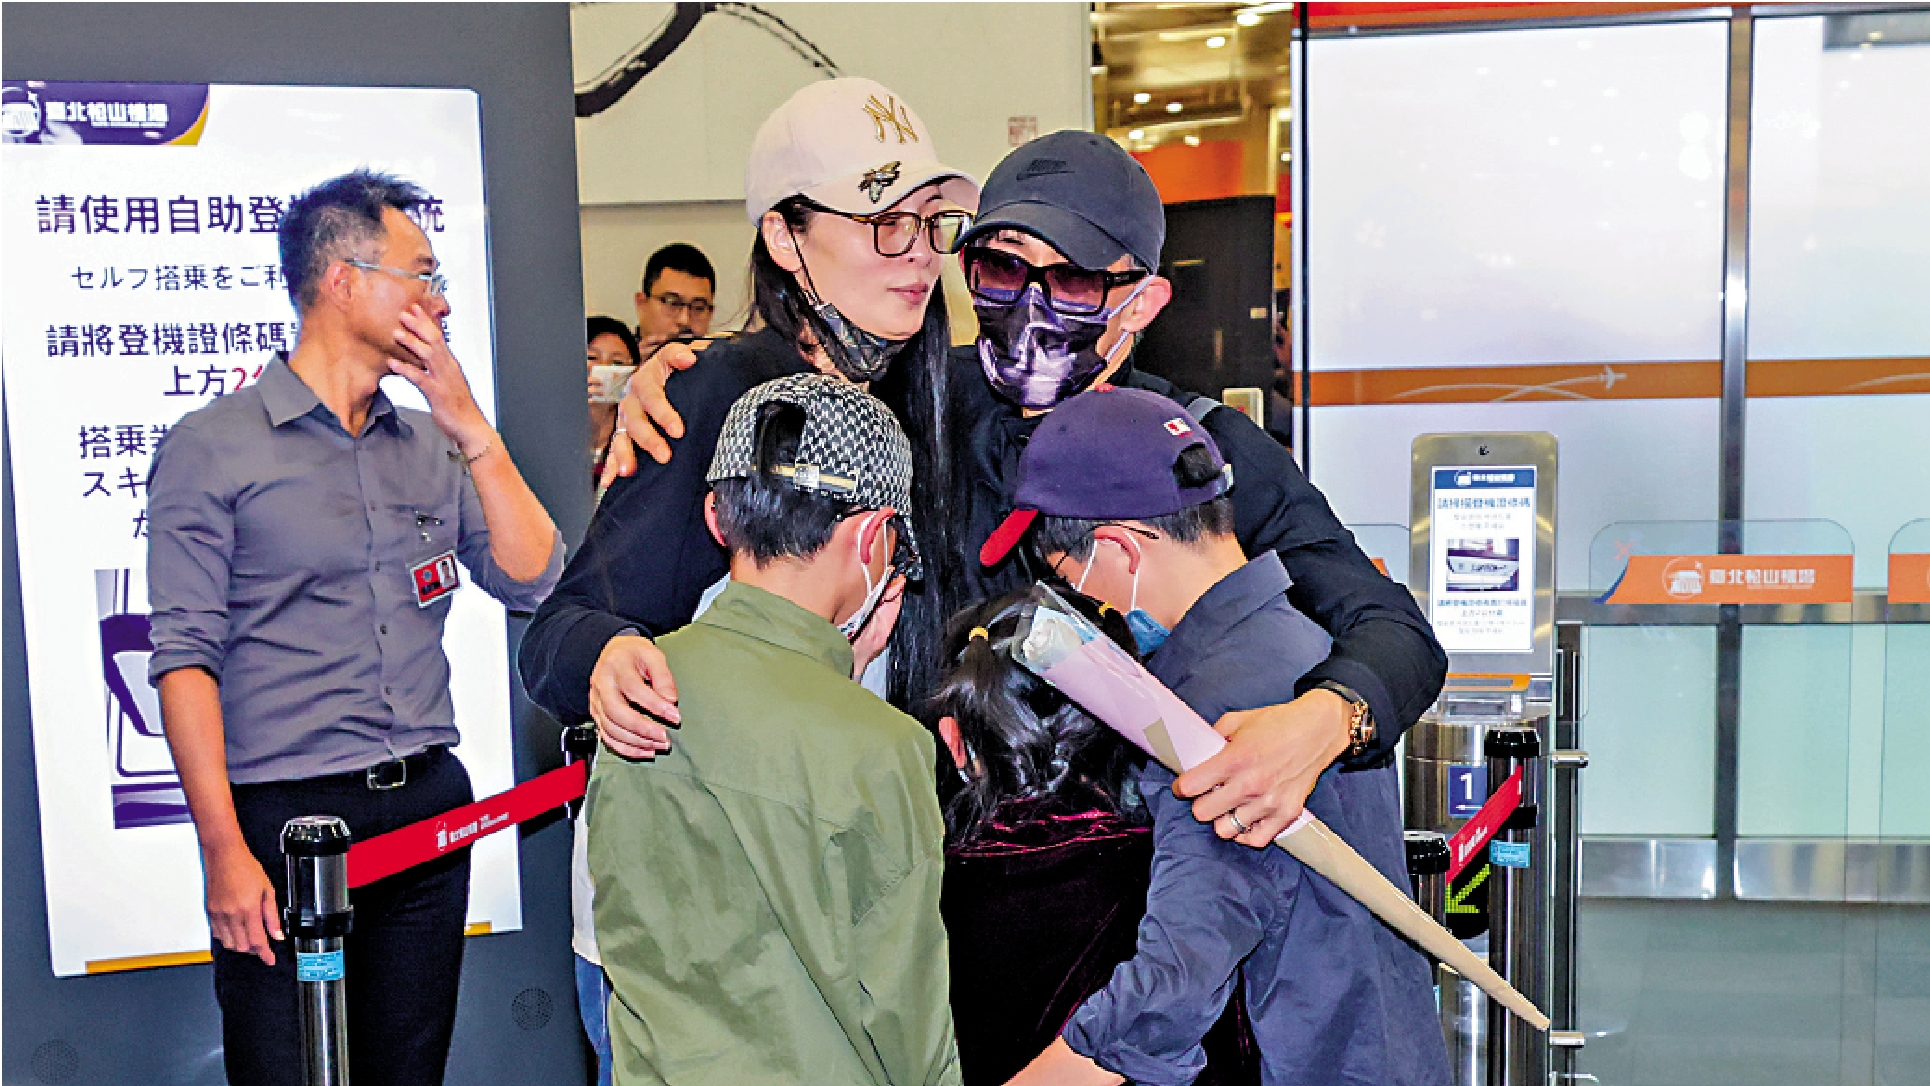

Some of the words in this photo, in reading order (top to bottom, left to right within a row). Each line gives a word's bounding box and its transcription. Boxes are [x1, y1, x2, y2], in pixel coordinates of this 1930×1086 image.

[862, 94, 919, 143] NY
[71, 264, 289, 291] セルフ搭乗をご利
[45, 322, 298, 358] 請將登機證條碼
[163, 364, 264, 397] 上方2
[1460, 772, 1472, 800] 1
